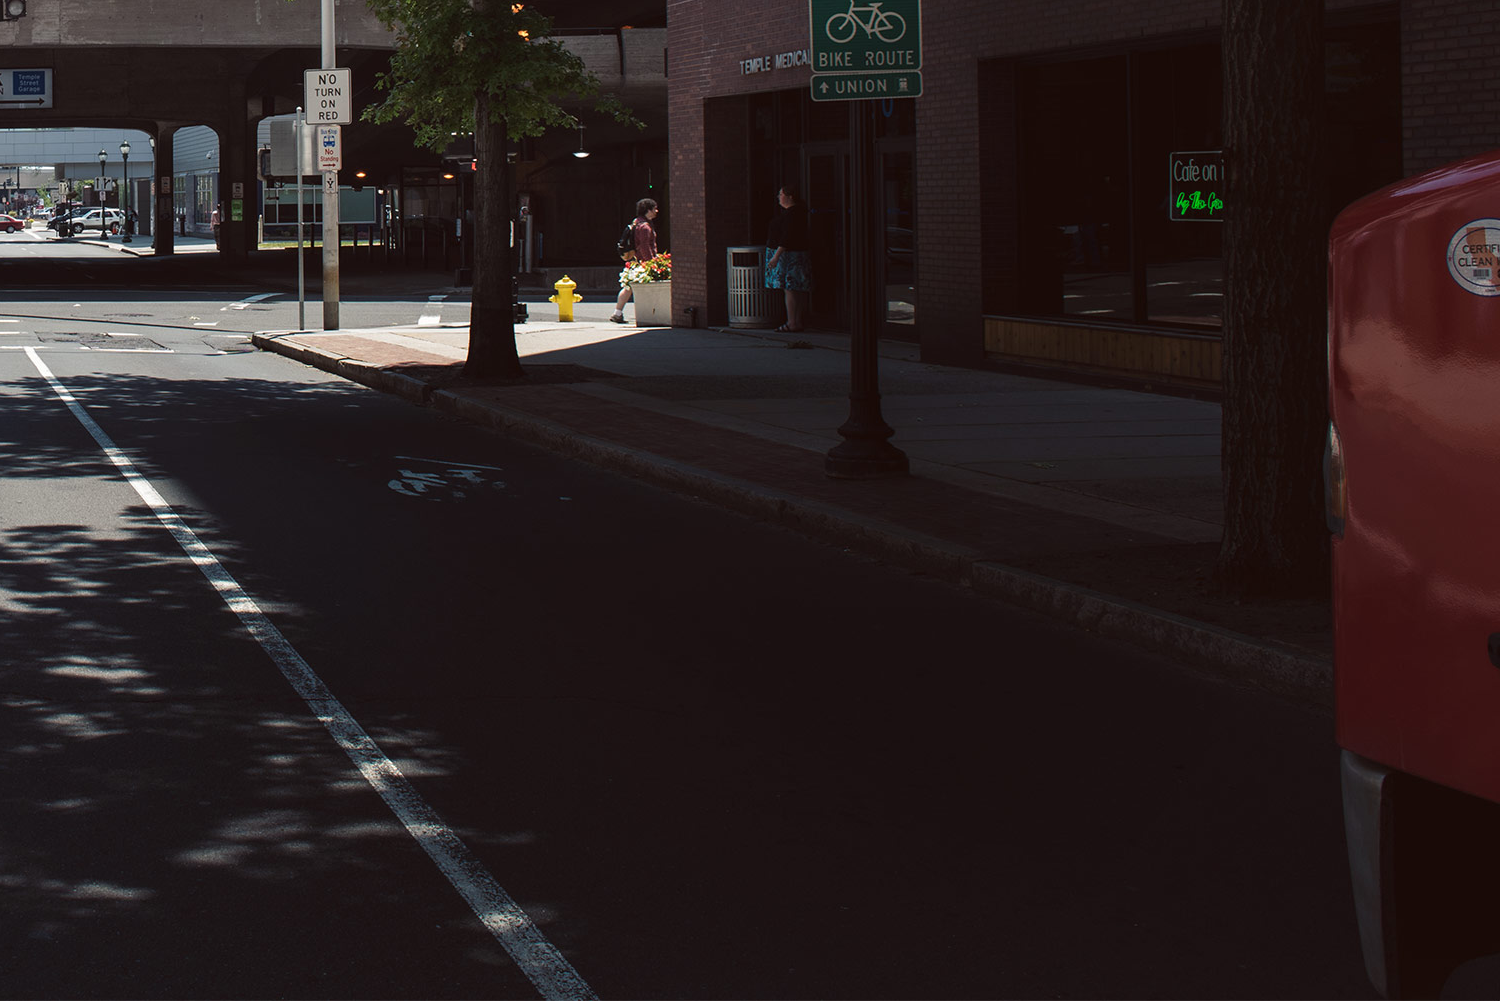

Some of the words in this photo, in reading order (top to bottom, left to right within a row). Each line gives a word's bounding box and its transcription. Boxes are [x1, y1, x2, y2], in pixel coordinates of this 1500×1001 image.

[739, 56, 772, 75] TEMPLE
[775, 49, 811, 70] MEDICAL
[819, 52, 853, 67] BIKE
[865, 50, 914, 66] ROUTE
[318, 74, 337, 85] NO
[835, 79, 887, 94] UNION
[315, 88, 341, 96] TURN
[321, 100, 335, 108] ON
[319, 112, 338, 120] RED
[1202, 164, 1217, 181] on
[1462, 244, 1500, 254] CERTIFI
[1458, 257, 1492, 267] CLEAN
